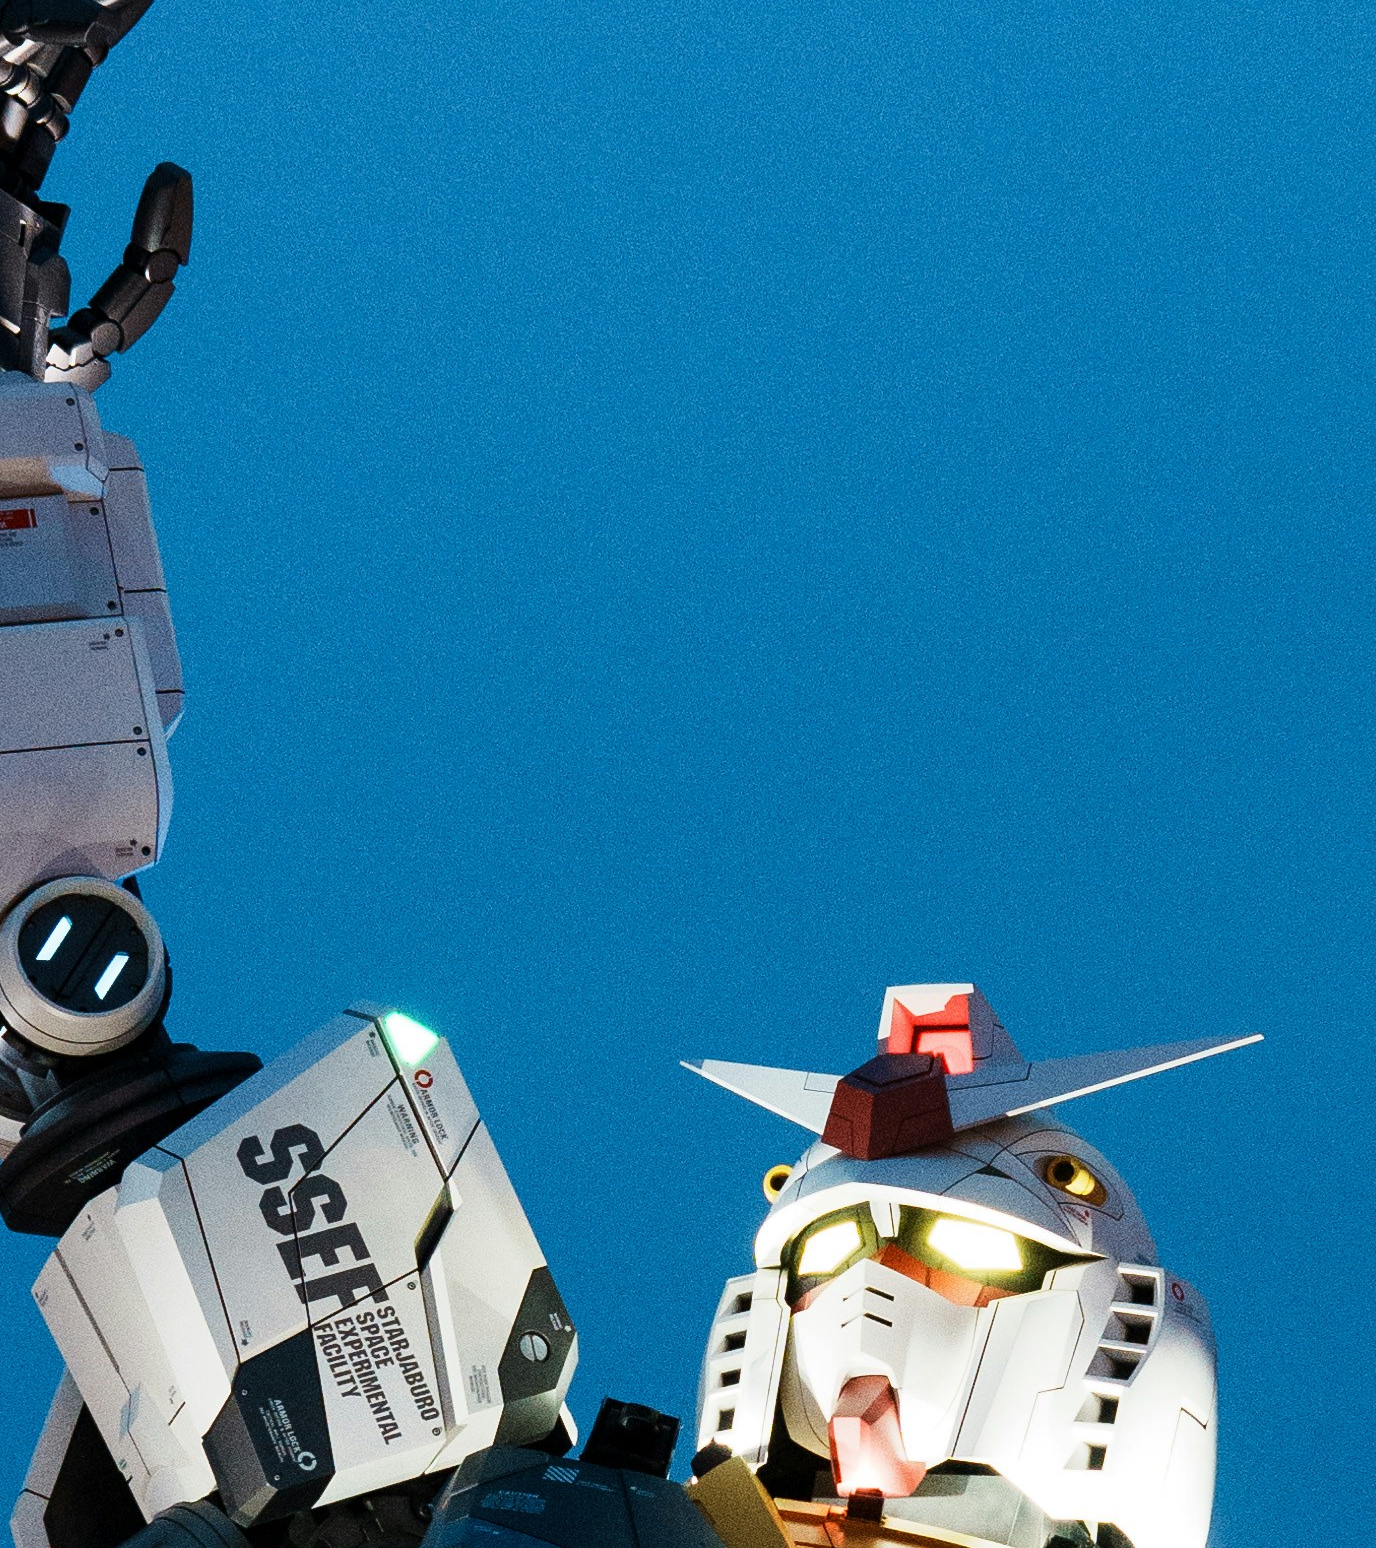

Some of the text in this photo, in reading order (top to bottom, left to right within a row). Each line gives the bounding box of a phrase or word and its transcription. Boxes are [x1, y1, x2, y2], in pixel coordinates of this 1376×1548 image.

[397, 1104, 419, 1144] WARNING
[420, 1089, 438, 1118] ARMOR
[434, 1116, 448, 1140] LOCK
[313, 1322, 362, 1398] FACILITY
[355, 1311, 395, 1370] SPACE
[376, 1305, 440, 1422] STARJABURO
[334, 1316, 403, 1446] EXPERIMENTAL
[273, 1399, 292, 1430] ARMOR
[287, 1430, 302, 1454] LOCK
